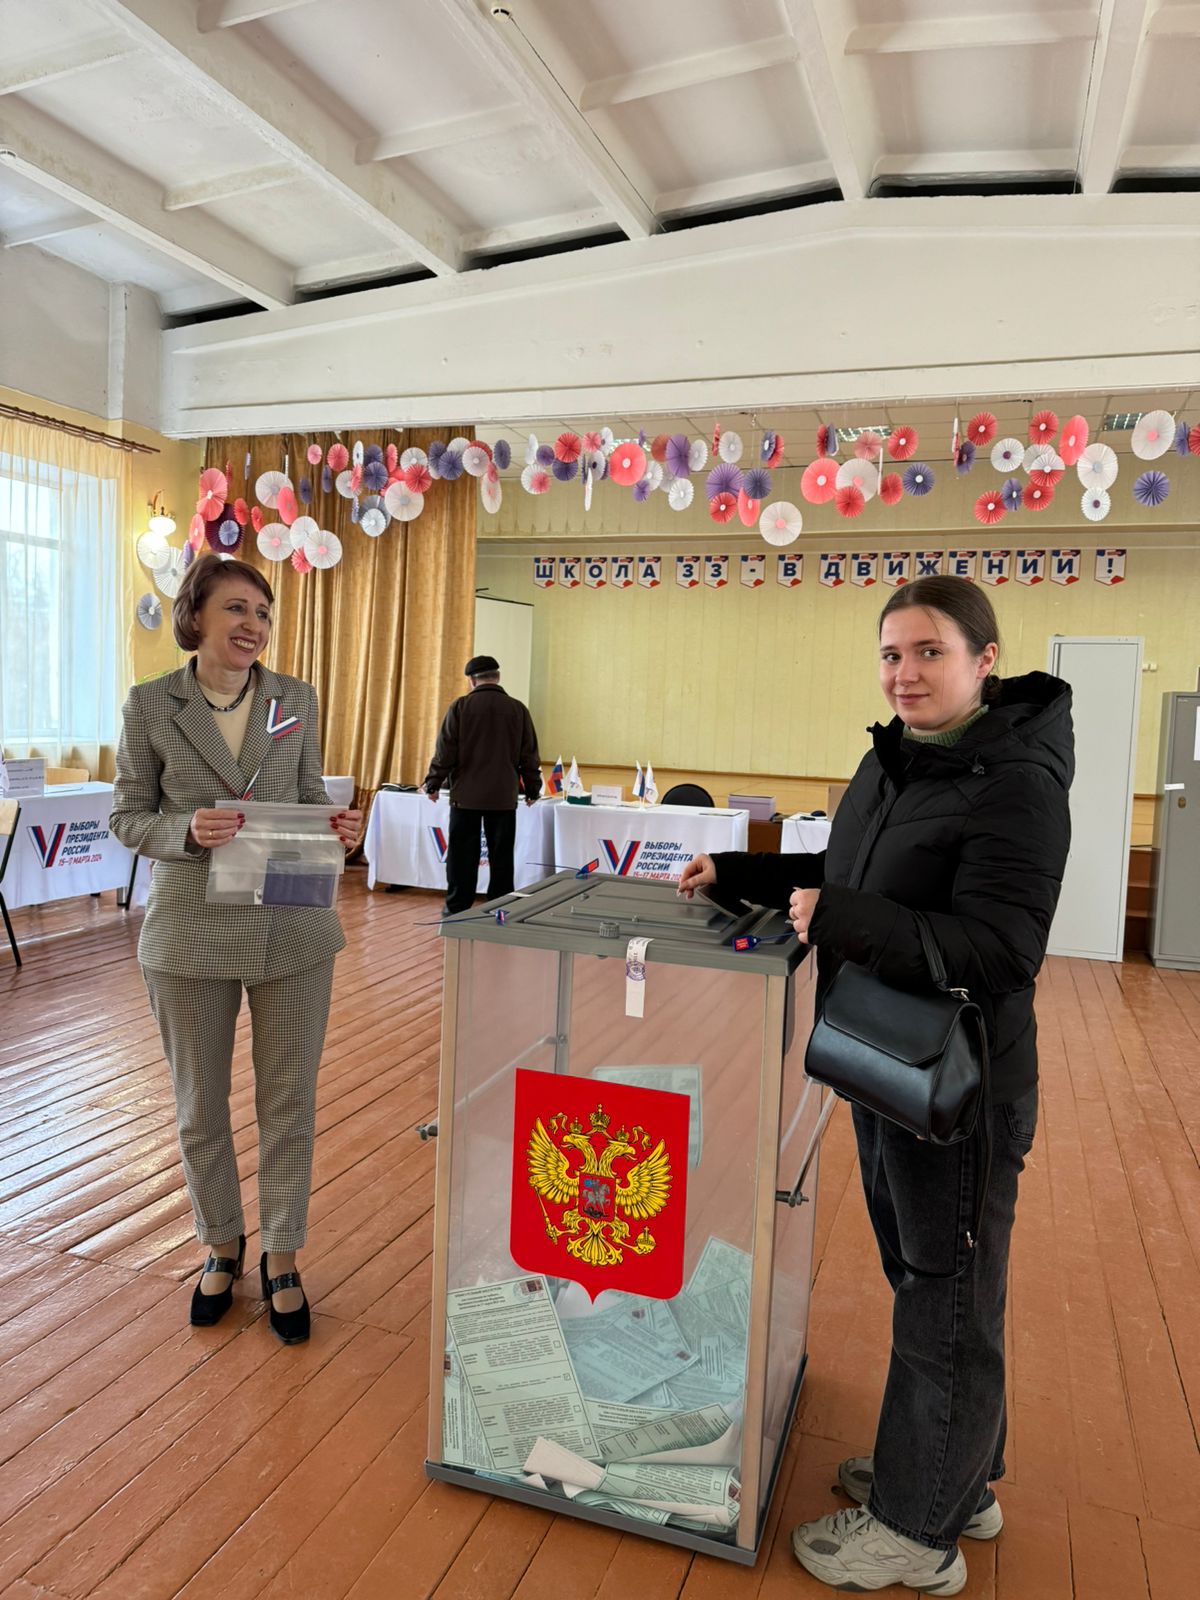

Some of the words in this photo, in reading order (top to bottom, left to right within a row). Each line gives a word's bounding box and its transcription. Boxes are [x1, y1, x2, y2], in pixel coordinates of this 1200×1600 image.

[535, 564, 656, 579] ШКОЛА
[783, 562, 798, 577] В
[824, 558, 1073, 580] ДВИЖЕНИИ
[69, 820, 100, 832] ВЫБОРЫ
[65, 831, 109, 844] ПРЕЗИДЕНТА
[61, 845, 91, 856] РОССИИ
[644, 841, 682, 851] ВЫБОРЫ
[640, 851, 694, 862] ПРЕЗИДЕНТА
[635, 862, 670, 871] РОССИИ
[649, 872, 671, 880] МАРТА
